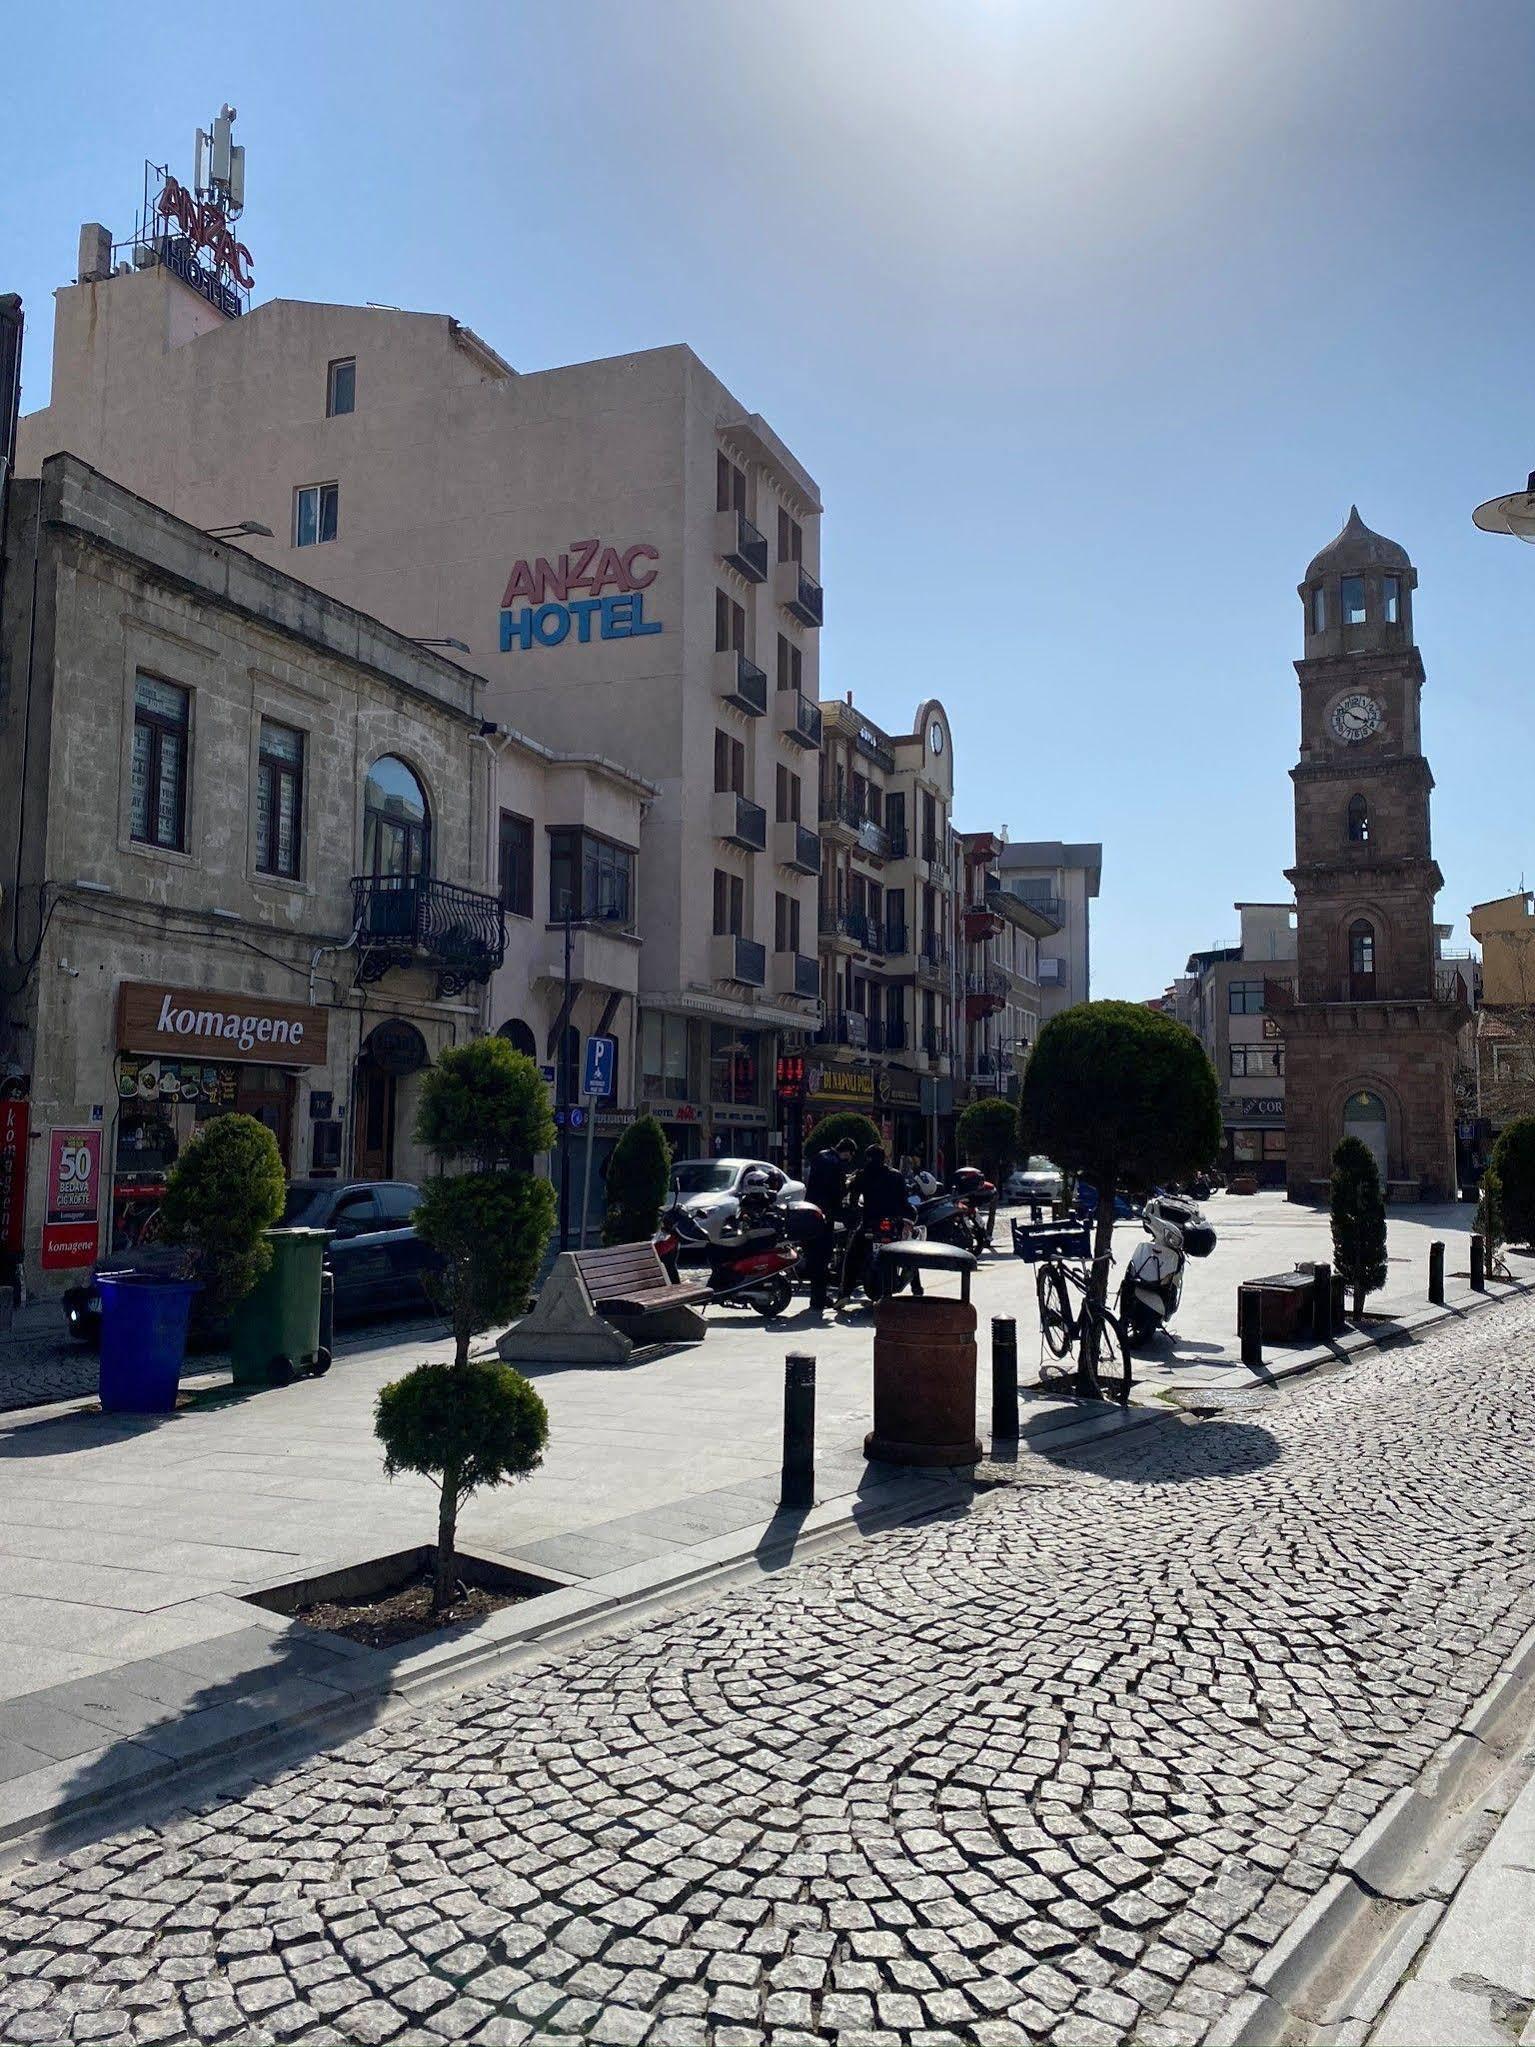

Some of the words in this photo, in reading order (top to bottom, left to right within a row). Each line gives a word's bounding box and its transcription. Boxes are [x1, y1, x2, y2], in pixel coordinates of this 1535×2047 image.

[158, 176, 255, 289] ANZAC
[501, 539, 660, 608] ANZAC
[500, 592, 662, 652] HOTEL
[157, 994, 304, 1051] komagene
[594, 1040, 605, 1067] P
[59, 1146, 92, 1182] 50
[48, 1240, 94, 1255] komagene
